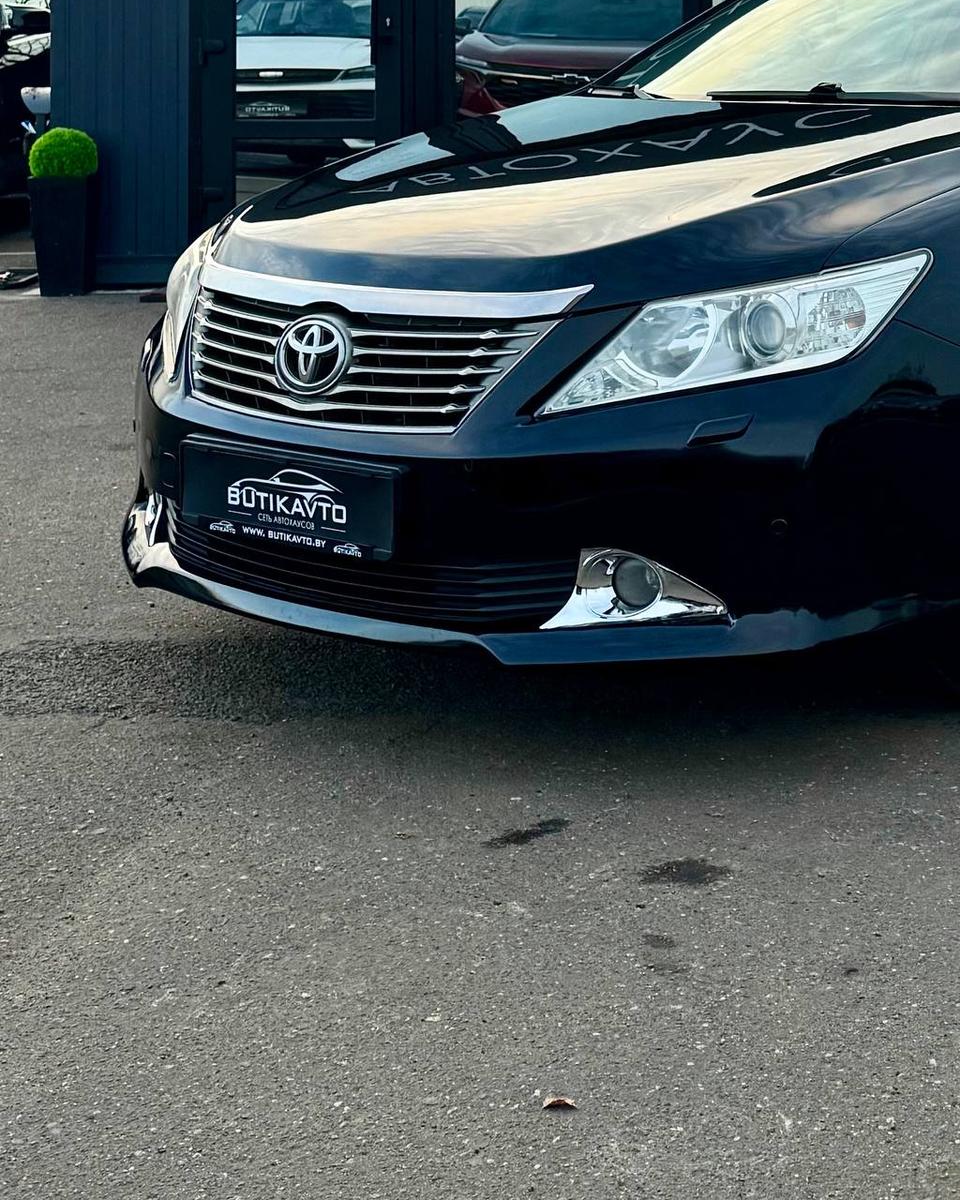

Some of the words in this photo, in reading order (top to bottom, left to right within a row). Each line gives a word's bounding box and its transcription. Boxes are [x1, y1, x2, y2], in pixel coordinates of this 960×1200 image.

[227, 487, 347, 524] BUTIKAVTO
[257, 513, 273, 523] СЕТЬ
[273, 516, 315, 531] АВТОХАУСОВ
[242, 525, 266, 538] WWW.
[268, 531, 327, 549] BUTIKAVTO.BY
